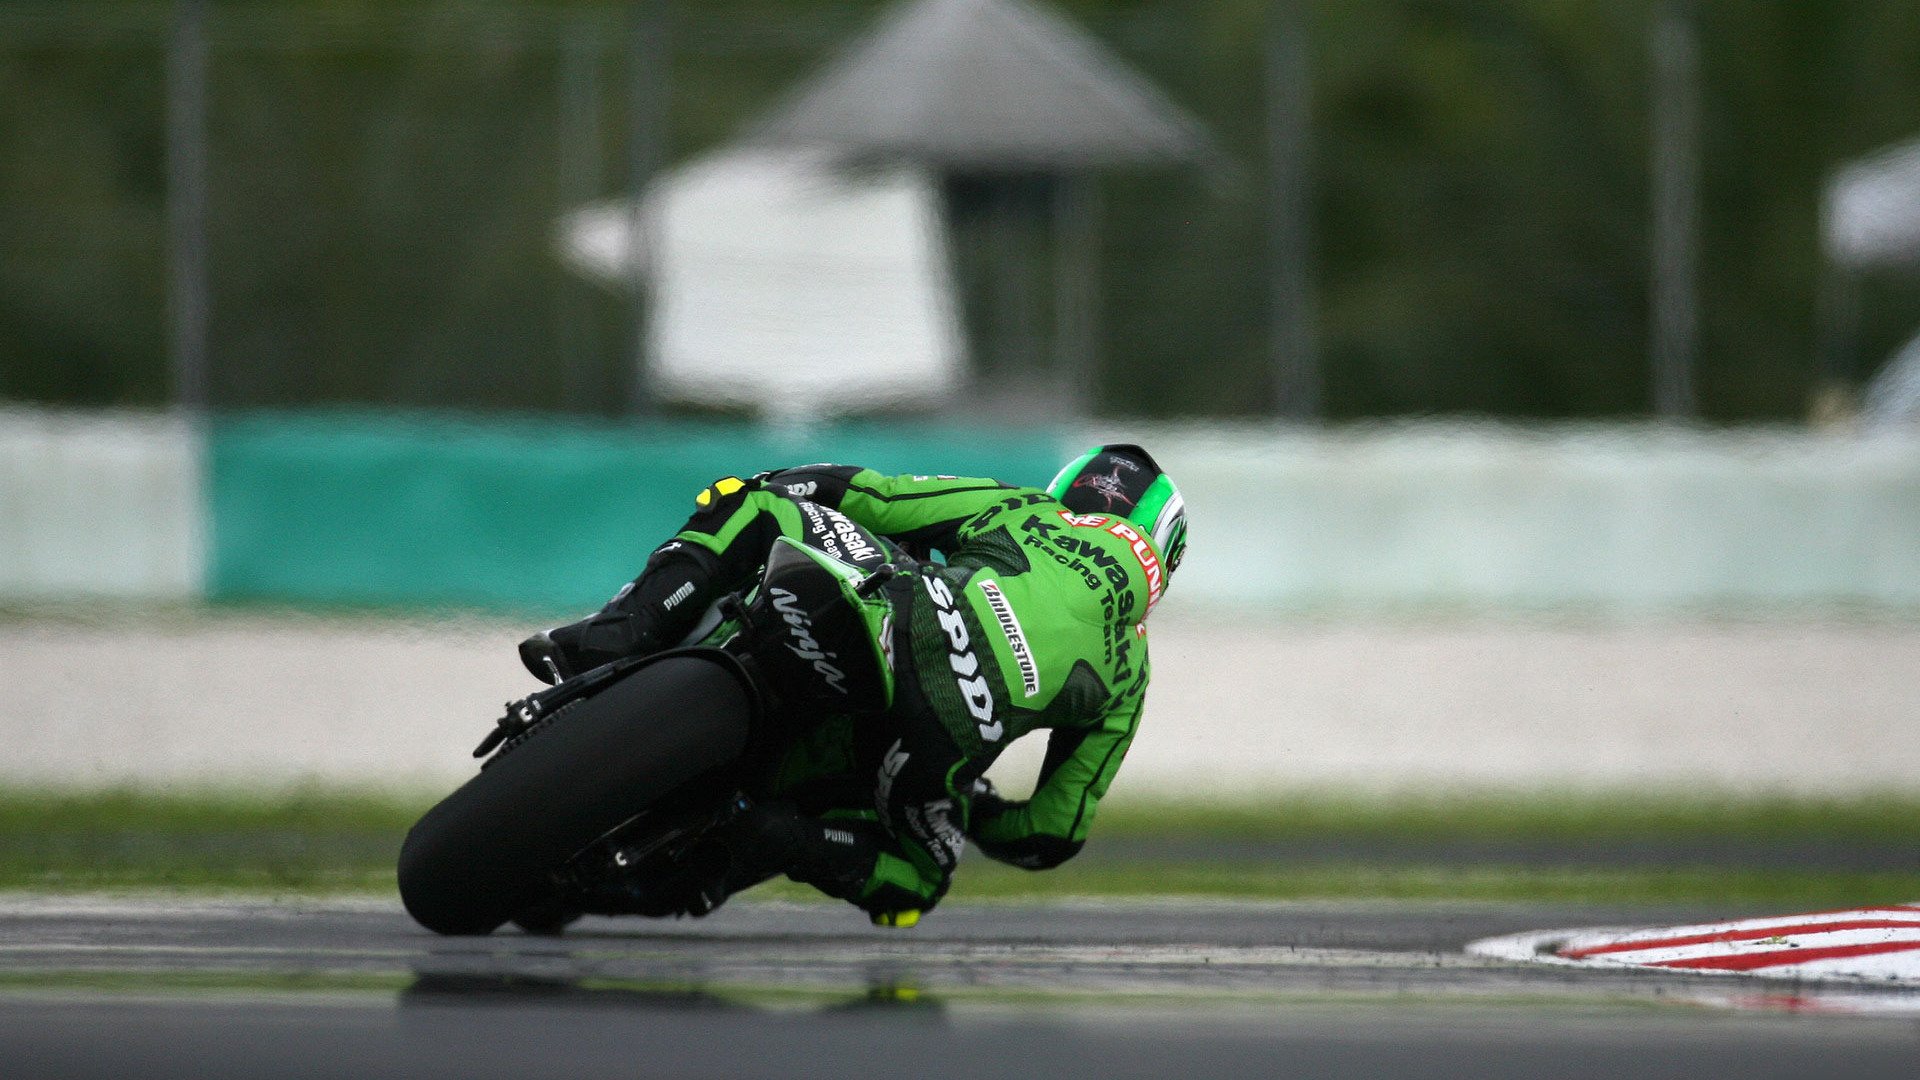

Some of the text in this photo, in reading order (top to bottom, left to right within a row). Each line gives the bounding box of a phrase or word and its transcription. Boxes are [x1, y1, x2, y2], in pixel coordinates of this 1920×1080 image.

[769, 587, 848, 694] Ninja
[922, 575, 1003, 742] SPIDI
[980, 583, 1036, 692] BRIDGESTONE
[1020, 513, 1135, 685] Kawasaki
[1023, 535, 1115, 665] Racing Team
